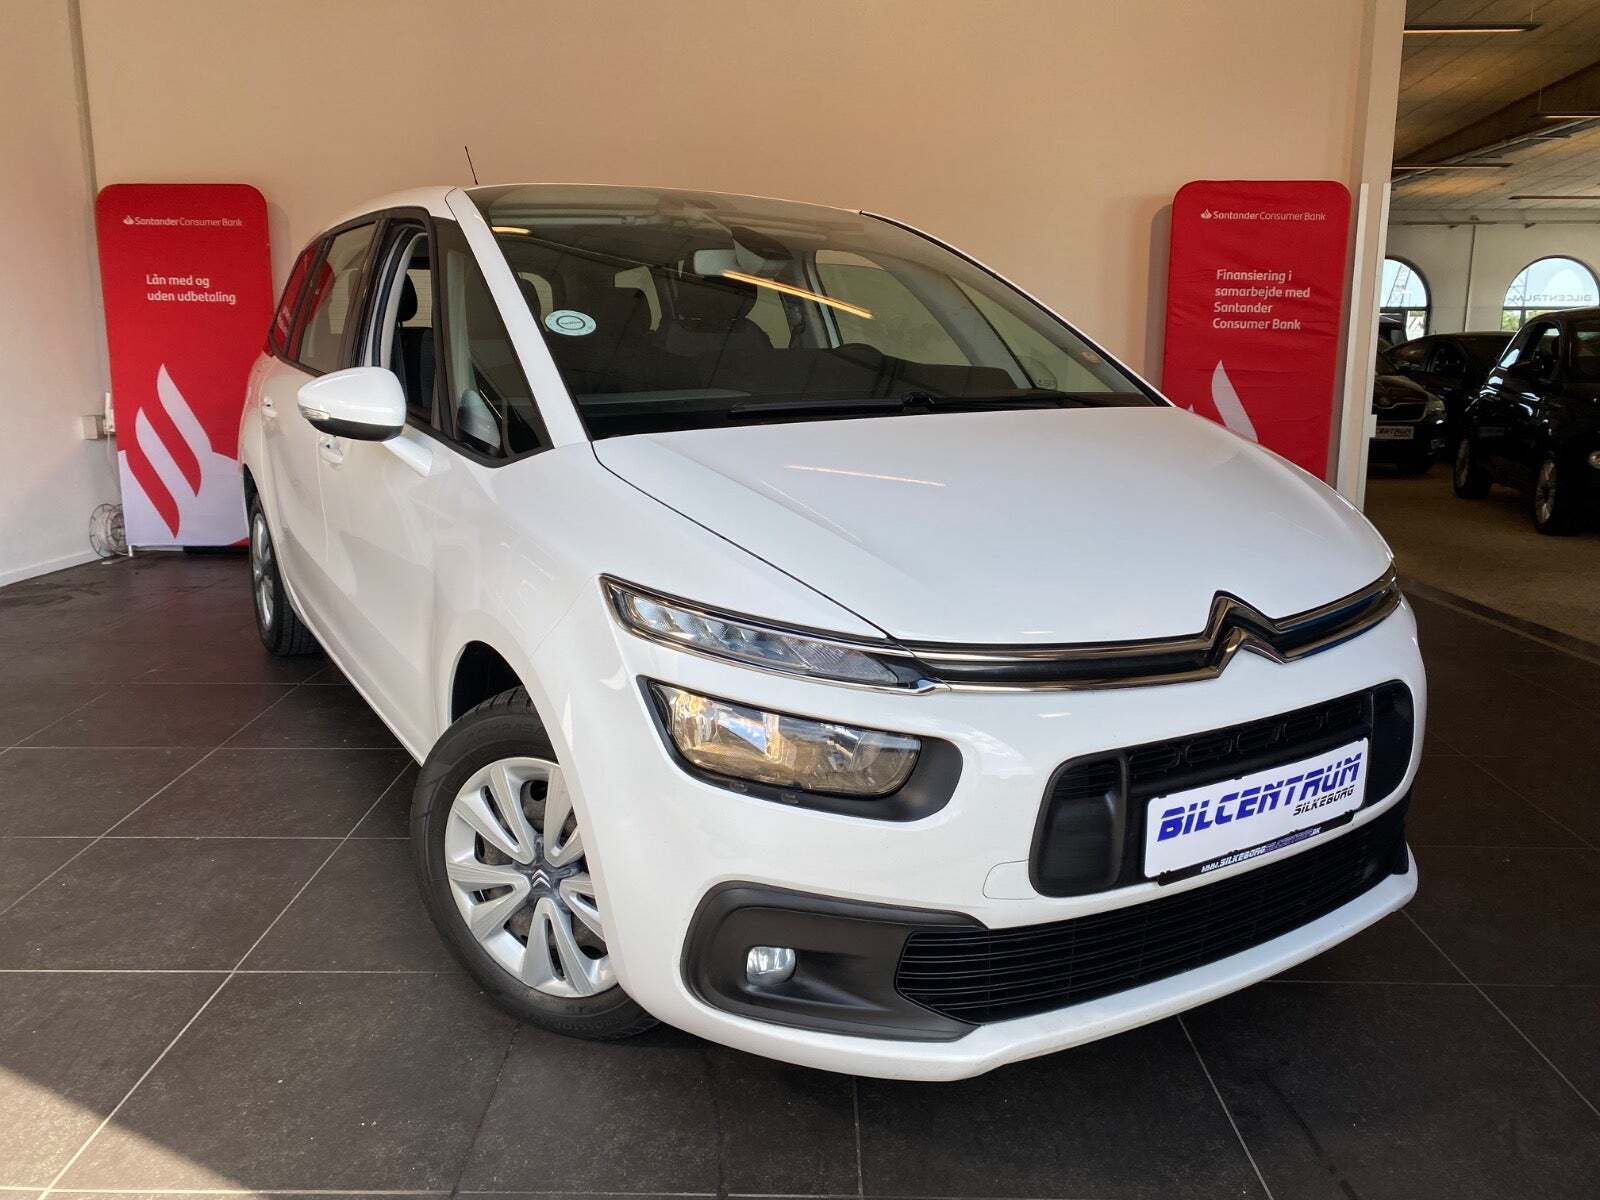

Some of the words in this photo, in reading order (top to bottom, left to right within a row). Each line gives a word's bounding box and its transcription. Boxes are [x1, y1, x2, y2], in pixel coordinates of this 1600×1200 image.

[135, 216, 178, 226] Santander
[179, 218, 221, 226] Consumer
[222, 218, 242, 226] Bank
[1213, 211, 1259, 220] Santander
[1259, 212, 1303, 221] Consumer
[1304, 212, 1326, 221] Bank
[146, 273, 167, 285] Lån
[169, 275, 193, 286] med
[195, 278, 210, 288] og
[1216, 269, 1286, 284] Finansiering
[1288, 270, 1293, 281] i
[147, 291, 175, 301] uden
[177, 291, 236, 305] udbetaling
[1215, 286, 1283, 300] samarbejde
[1285, 287, 1311, 298] med
[1214, 302, 1273, 313] Santander
[1213, 317, 1270, 329] Consumer
[1272, 318, 1301, 330] Bank
[1157, 752, 1362, 842] BILCENTRUM
[1293, 784, 1355, 816] SILKEBORG
